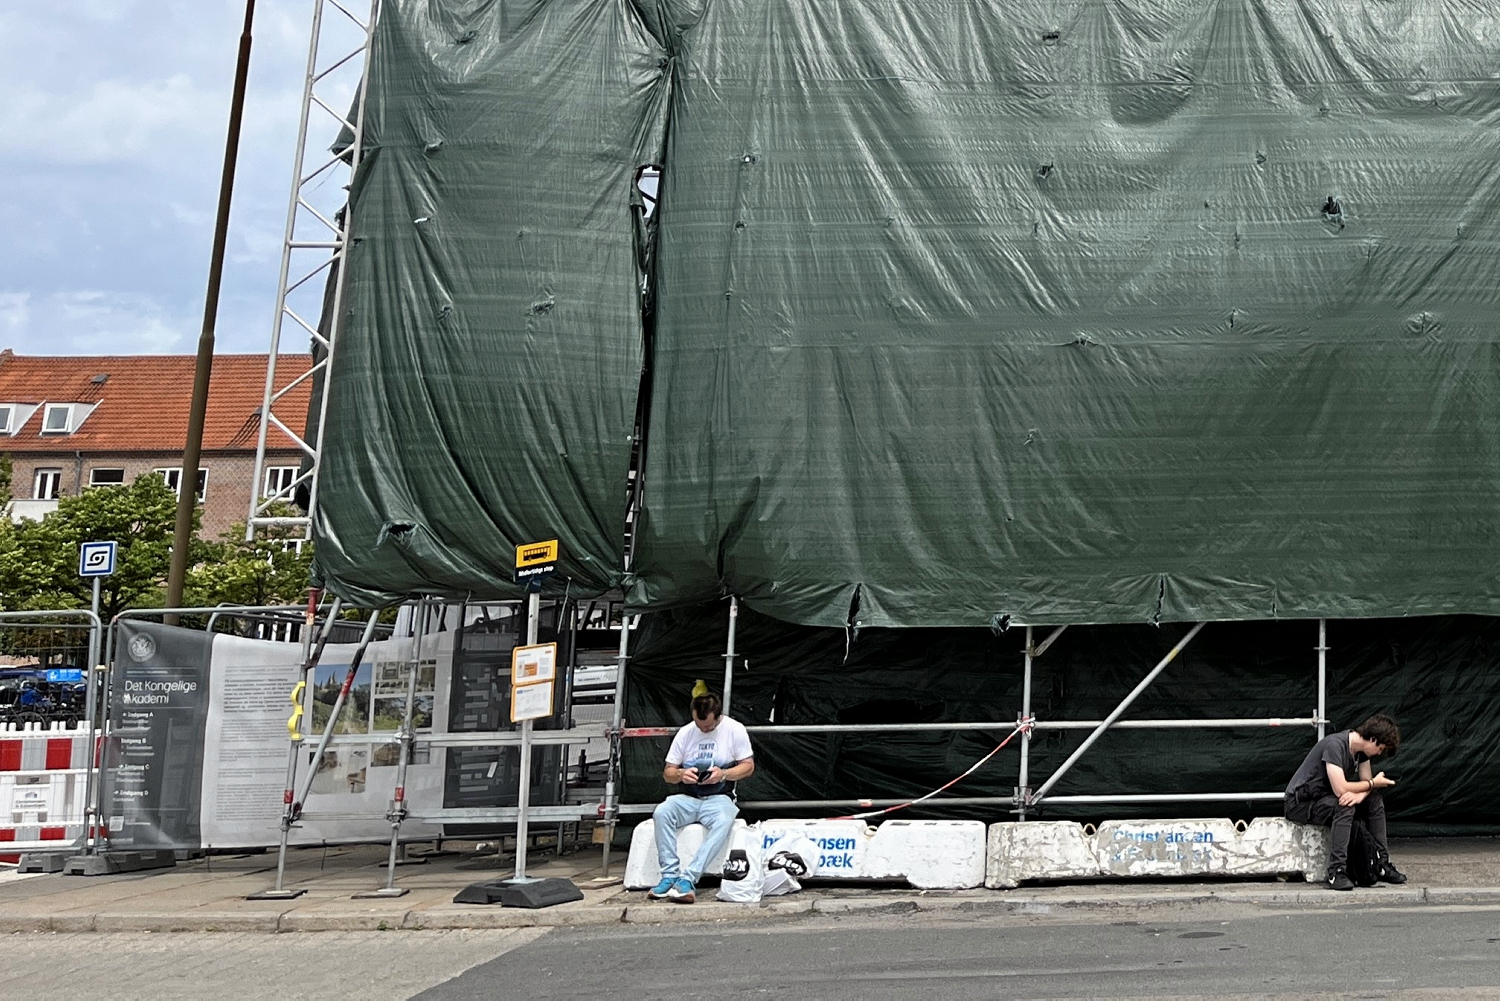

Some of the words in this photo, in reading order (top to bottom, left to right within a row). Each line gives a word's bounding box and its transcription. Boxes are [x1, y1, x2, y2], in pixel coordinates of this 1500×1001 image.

[125, 681, 142, 691] Det
[144, 681, 197, 694] Kongelige
[123, 693, 170, 704] Akademi
[696, 752, 713, 760] JAPAN
